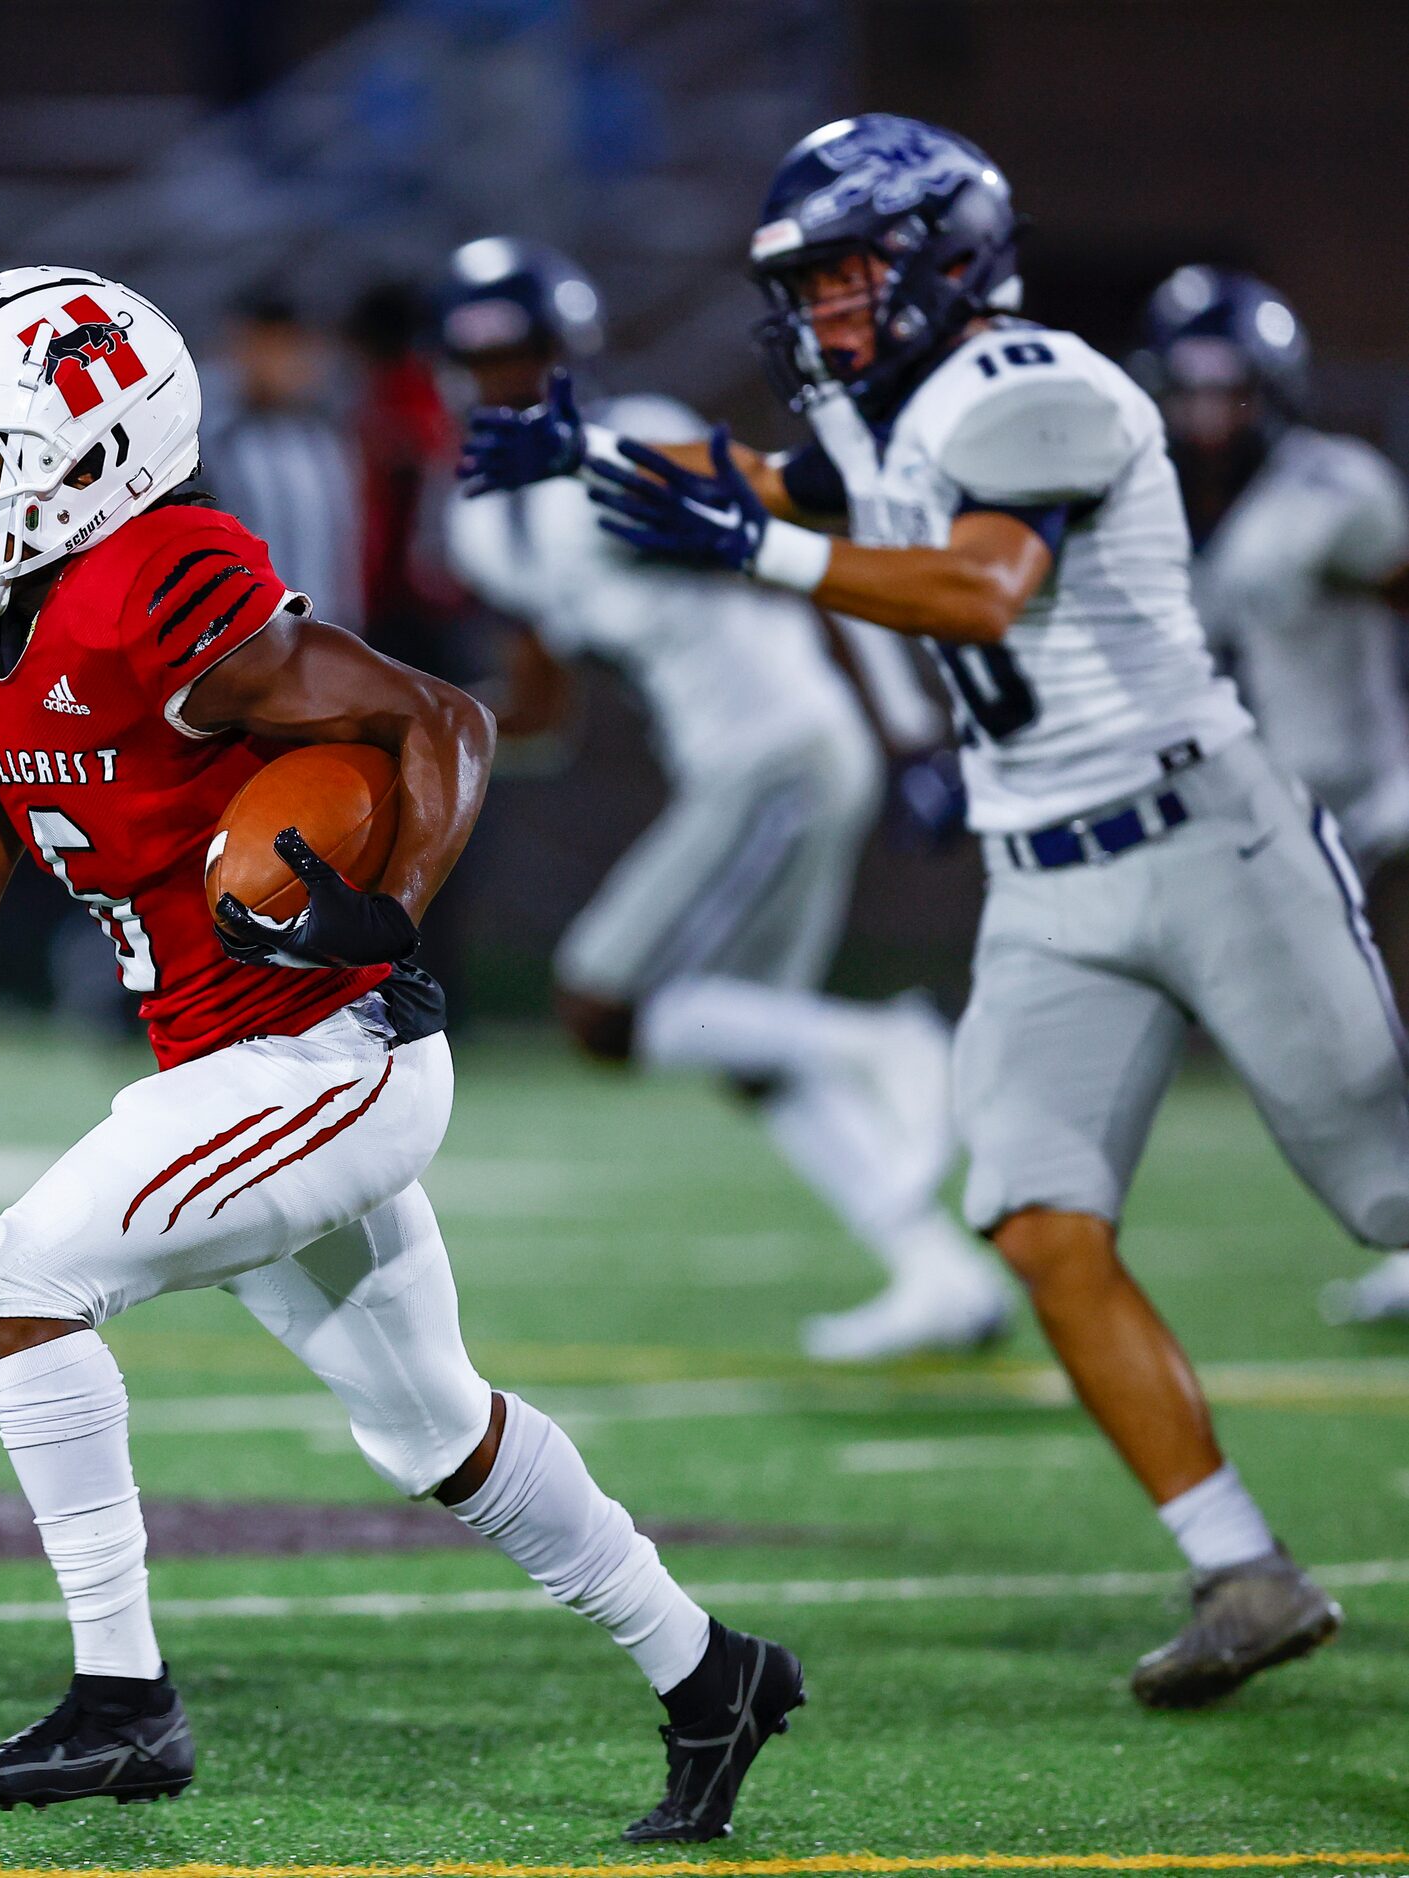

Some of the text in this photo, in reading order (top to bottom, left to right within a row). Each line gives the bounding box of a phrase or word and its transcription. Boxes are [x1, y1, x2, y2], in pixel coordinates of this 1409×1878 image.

[976, 343, 1055, 378] 10
[65, 509, 107, 551] schutt
[43, 698, 91, 715] adidas
